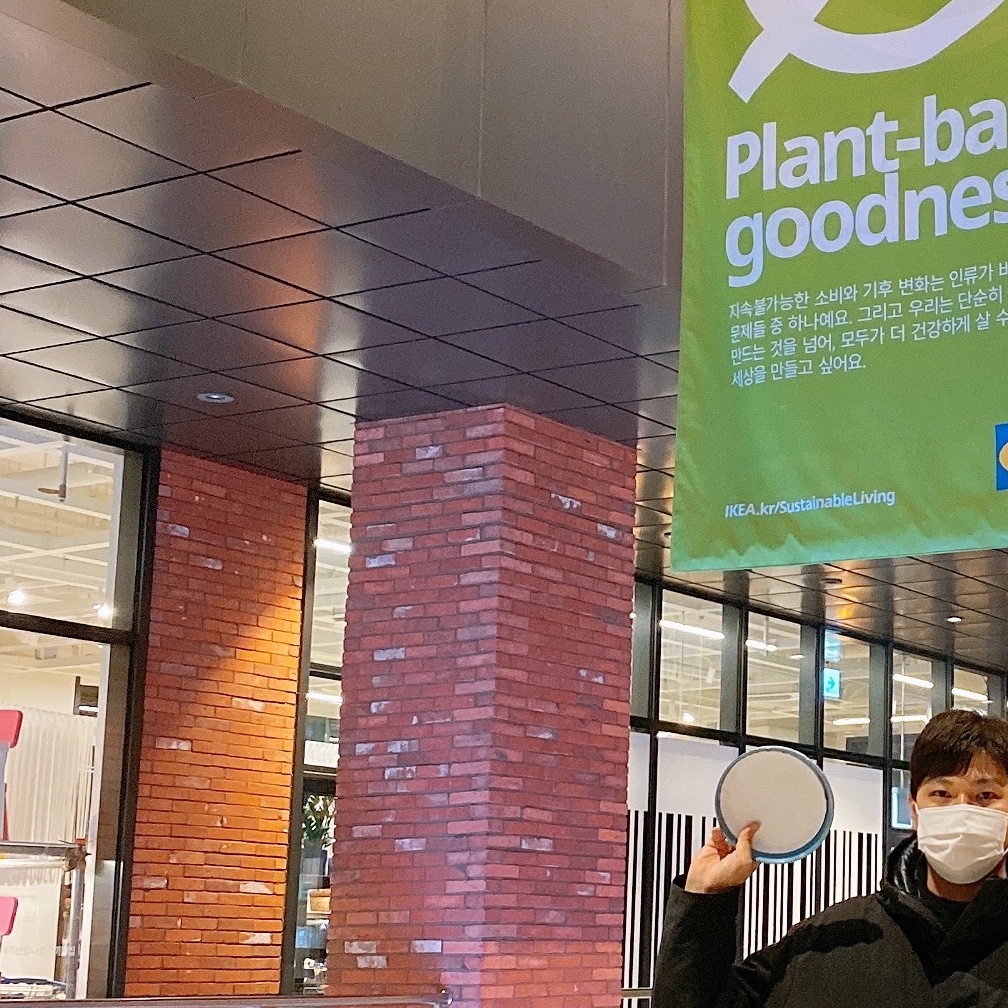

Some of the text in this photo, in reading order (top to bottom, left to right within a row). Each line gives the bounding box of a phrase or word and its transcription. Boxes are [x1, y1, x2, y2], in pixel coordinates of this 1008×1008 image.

[729, 291, 810, 319] 지속불가능한
[814, 285, 858, 306] 소비와
[863, 280, 893, 299] 기후
[899, 275, 944, 296] 변화는
[949, 263, 994, 288] 인류가
[730, 320, 766, 344] 문제들
[770, 316, 784, 336] 중
[788, 309, 853, 332] 하나예요.
[857, 302, 903, 323] 그리고
[908, 296, 954, 318] 우리는
[958, 285, 1003, 310] 단순히
[731, 344, 766, 366] 만드는
[771, 337, 797, 358] 것을
[803, 333, 836, 354] 넘어,
[840, 326, 885, 349] 모두가
[890, 324, 906, 342] 더
[911, 314, 970, 341] 건강하게
[975, 310, 990, 331] 살
[731, 353, 866, 388] 세상을 만들고 싶어요.
[725, 489, 896, 518] IKEA.kr/SustainableLiving
